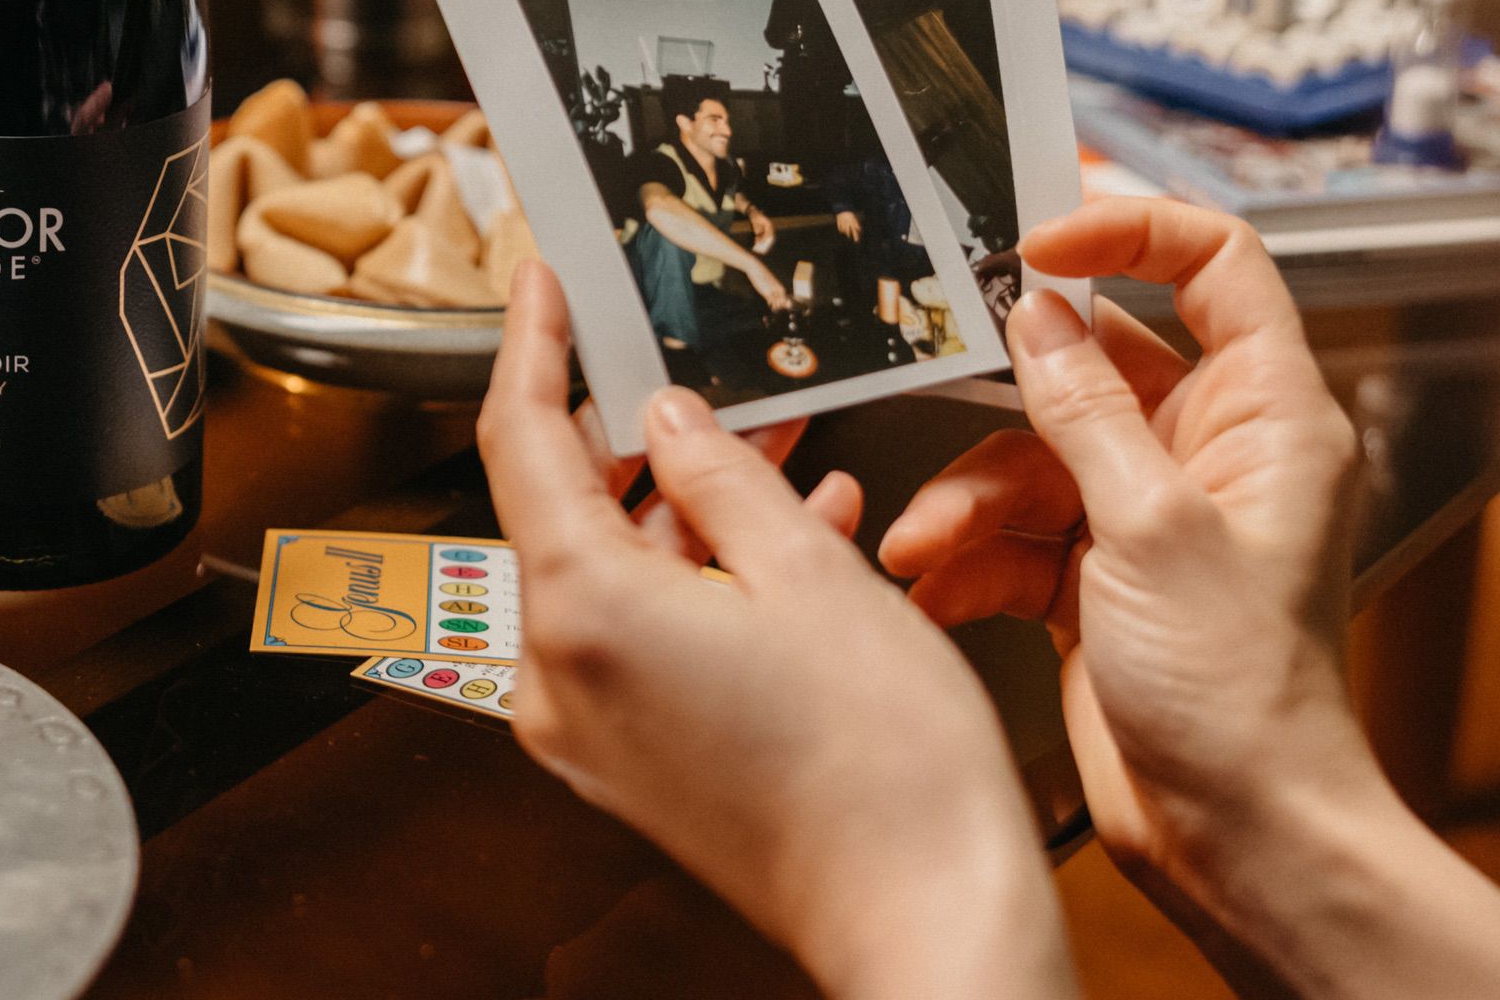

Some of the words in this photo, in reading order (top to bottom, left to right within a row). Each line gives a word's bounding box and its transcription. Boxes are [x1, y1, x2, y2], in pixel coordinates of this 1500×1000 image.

[455, 584, 471, 594] H
[447, 601, 482, 613] AL
[448, 620, 480, 631] SN
[446, 637, 478, 649] SL
[394, 663, 416, 674] G
[429, 672, 453, 684] E
[467, 683, 490, 695] H
